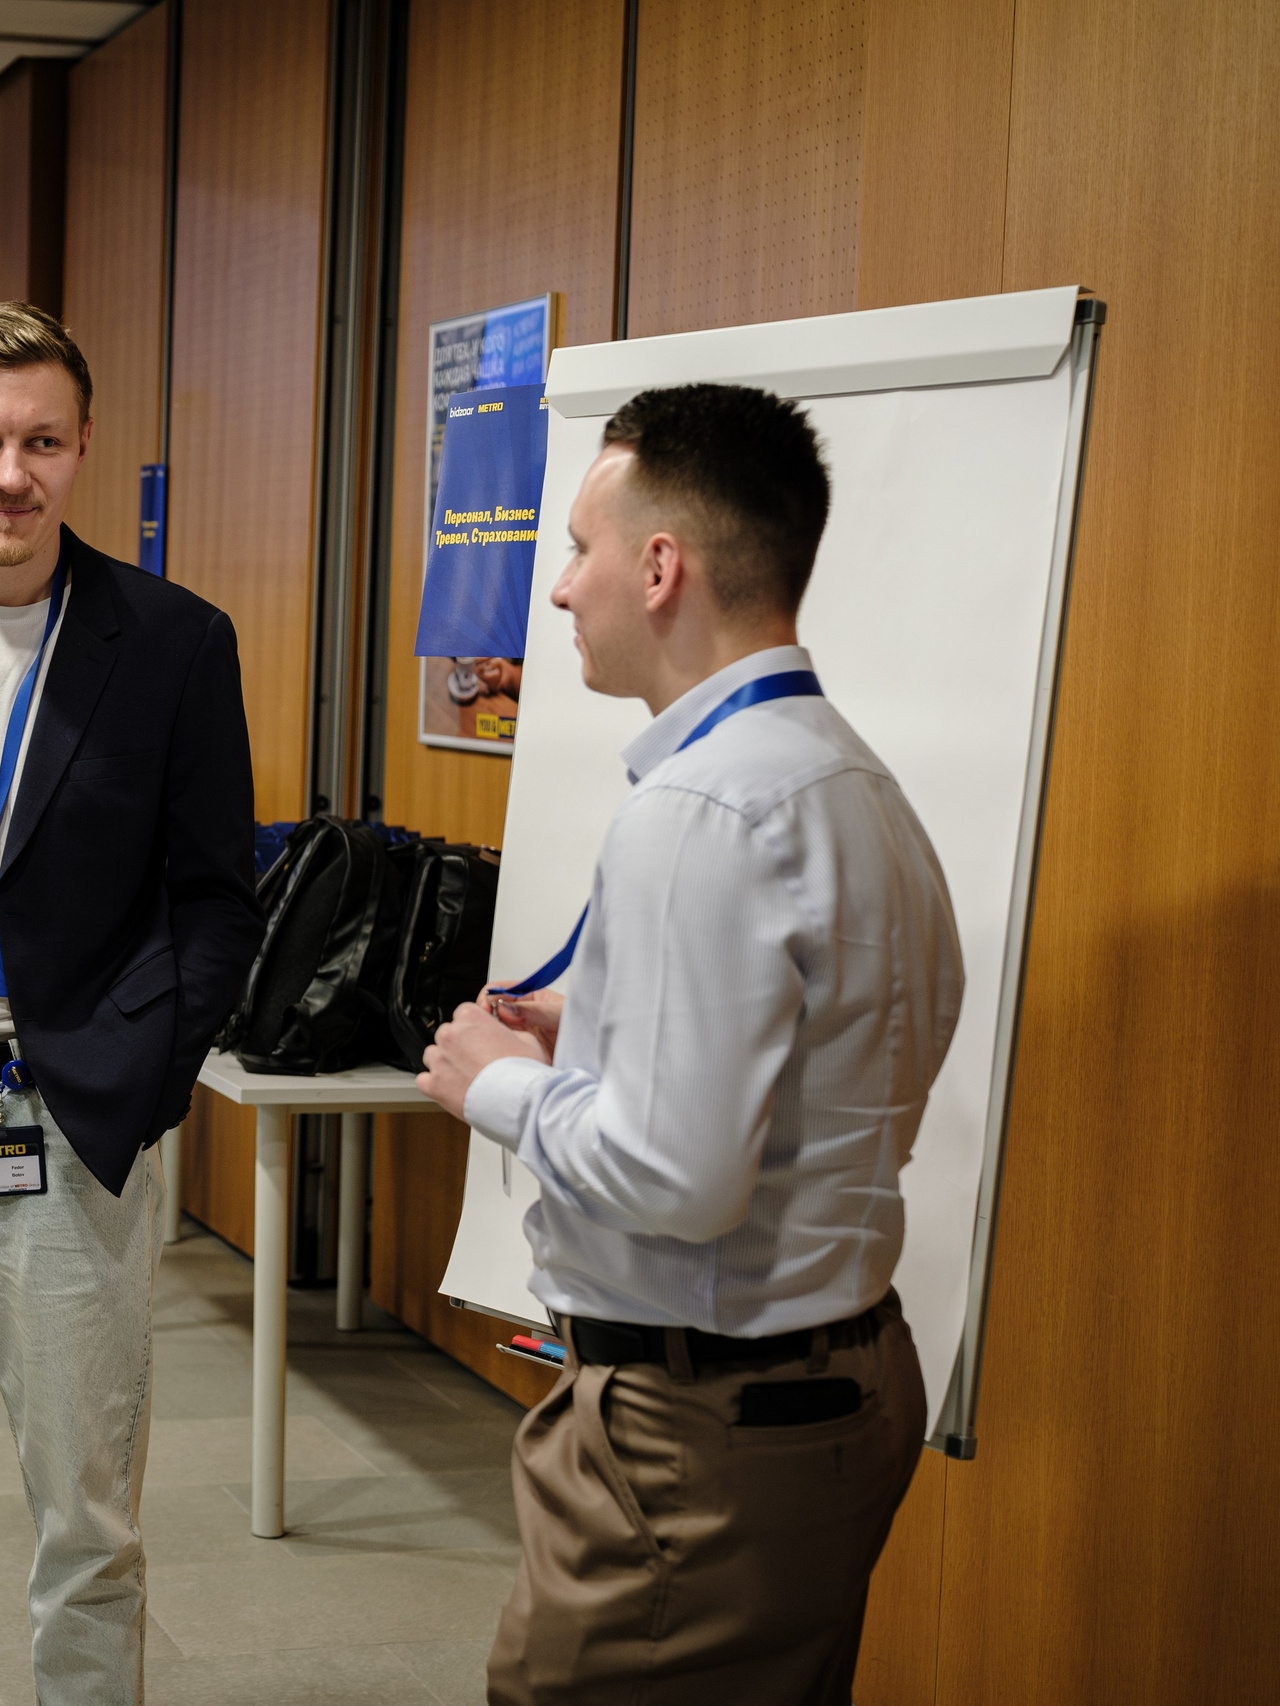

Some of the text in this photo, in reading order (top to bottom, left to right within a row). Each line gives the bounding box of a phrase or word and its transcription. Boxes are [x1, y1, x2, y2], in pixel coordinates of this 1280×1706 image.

[478, 402, 504, 413] METRO
[444, 506, 535, 528] Персонал, Бизнес
[436, 530, 469, 549] Тревел,
